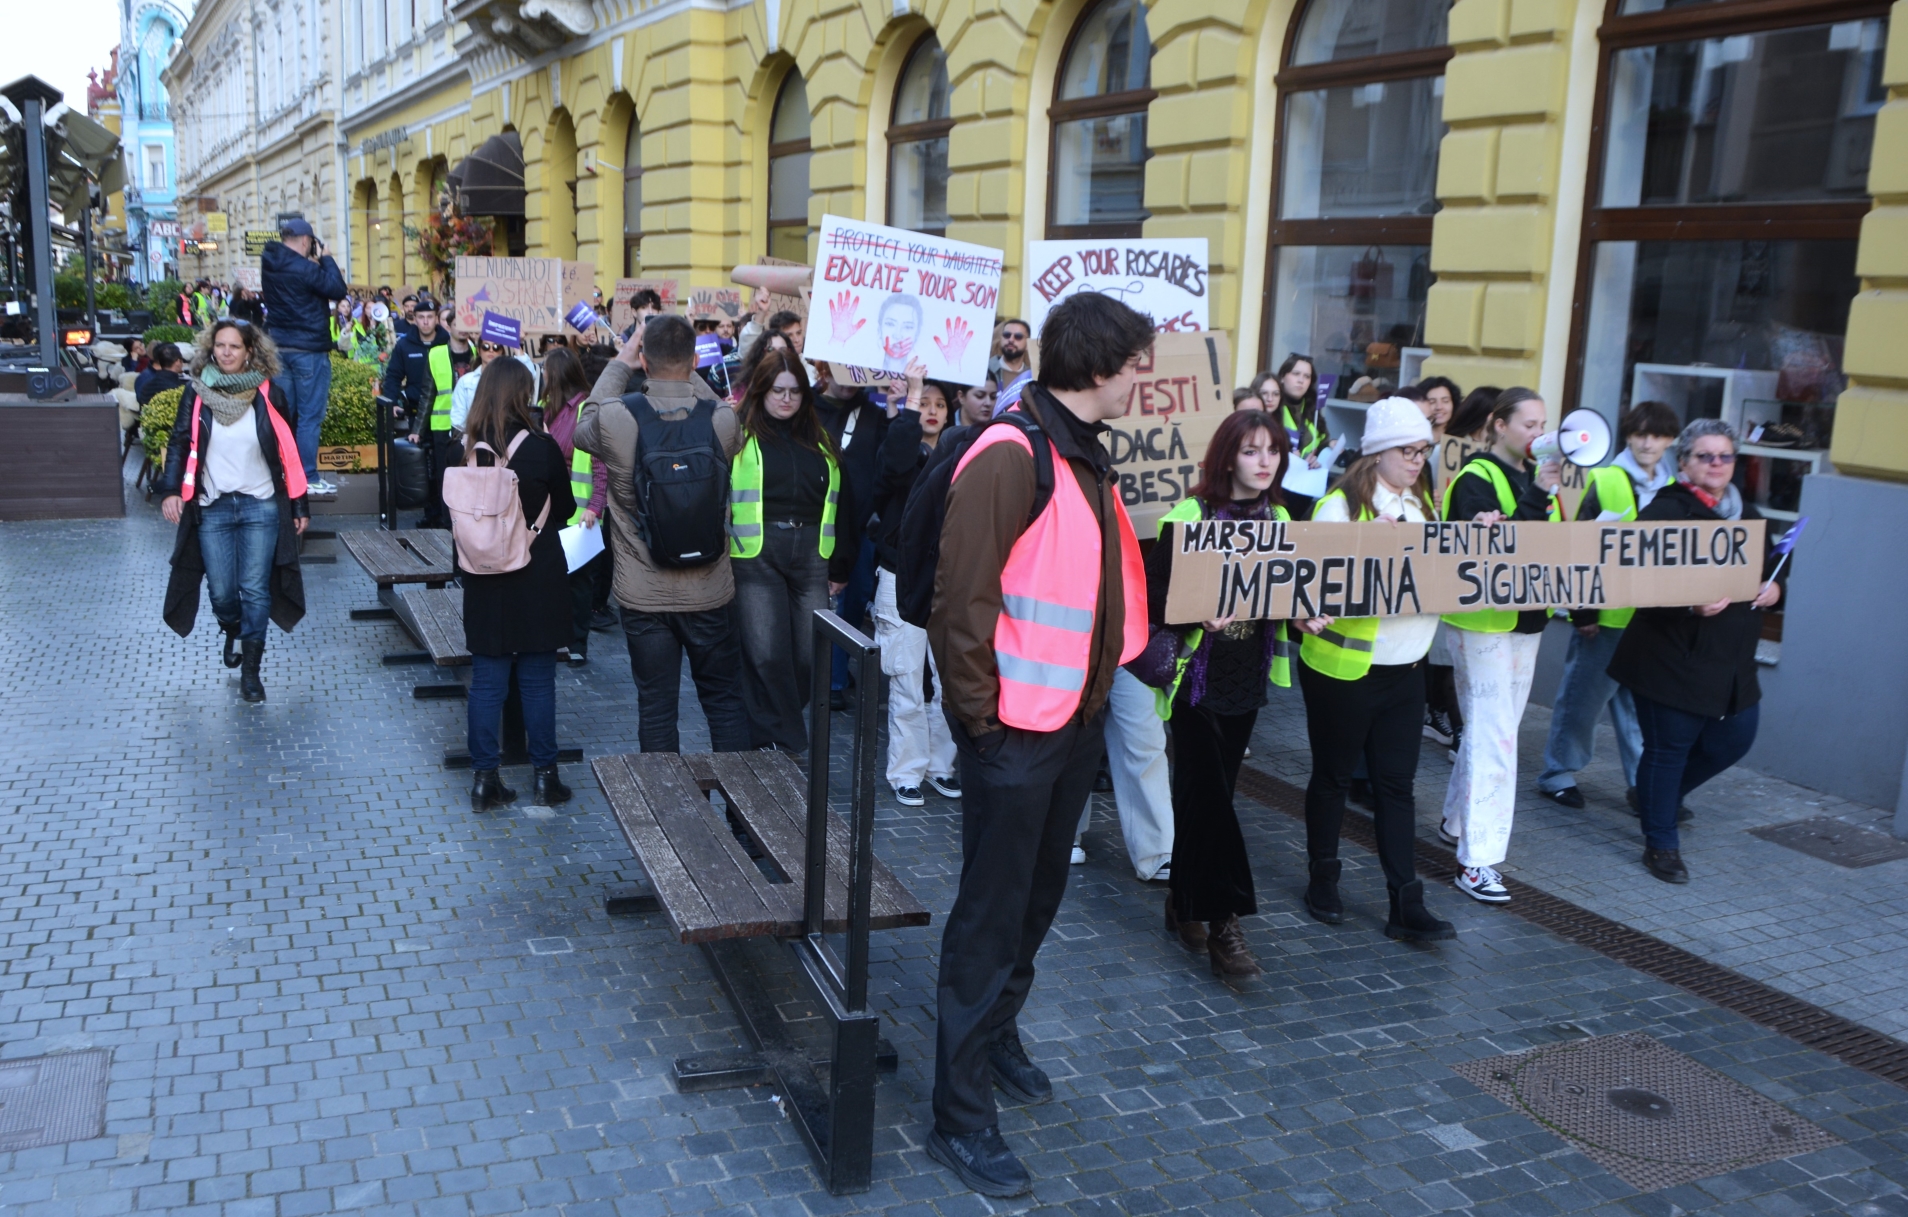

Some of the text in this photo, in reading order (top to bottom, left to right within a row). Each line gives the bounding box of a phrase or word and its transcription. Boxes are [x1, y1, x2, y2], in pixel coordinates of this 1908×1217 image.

[153, 222, 180, 236] ABC
[834, 227, 1002, 278] PROTECT YOUR DAUGHTER
[824, 254, 909, 293] EDUCATE
[917, 269, 957, 302] YOUR
[961, 281, 998, 309] SON
[1032, 255, 1075, 303] KEEP
[1077, 247, 1120, 277] YOUR
[1110, 422, 1189, 465] DACĂ
[1182, 520, 1749, 567] MARȘUL PENTRU FEMEILOR
[1215, 546, 1422, 619] ÎMPREUNĂ
